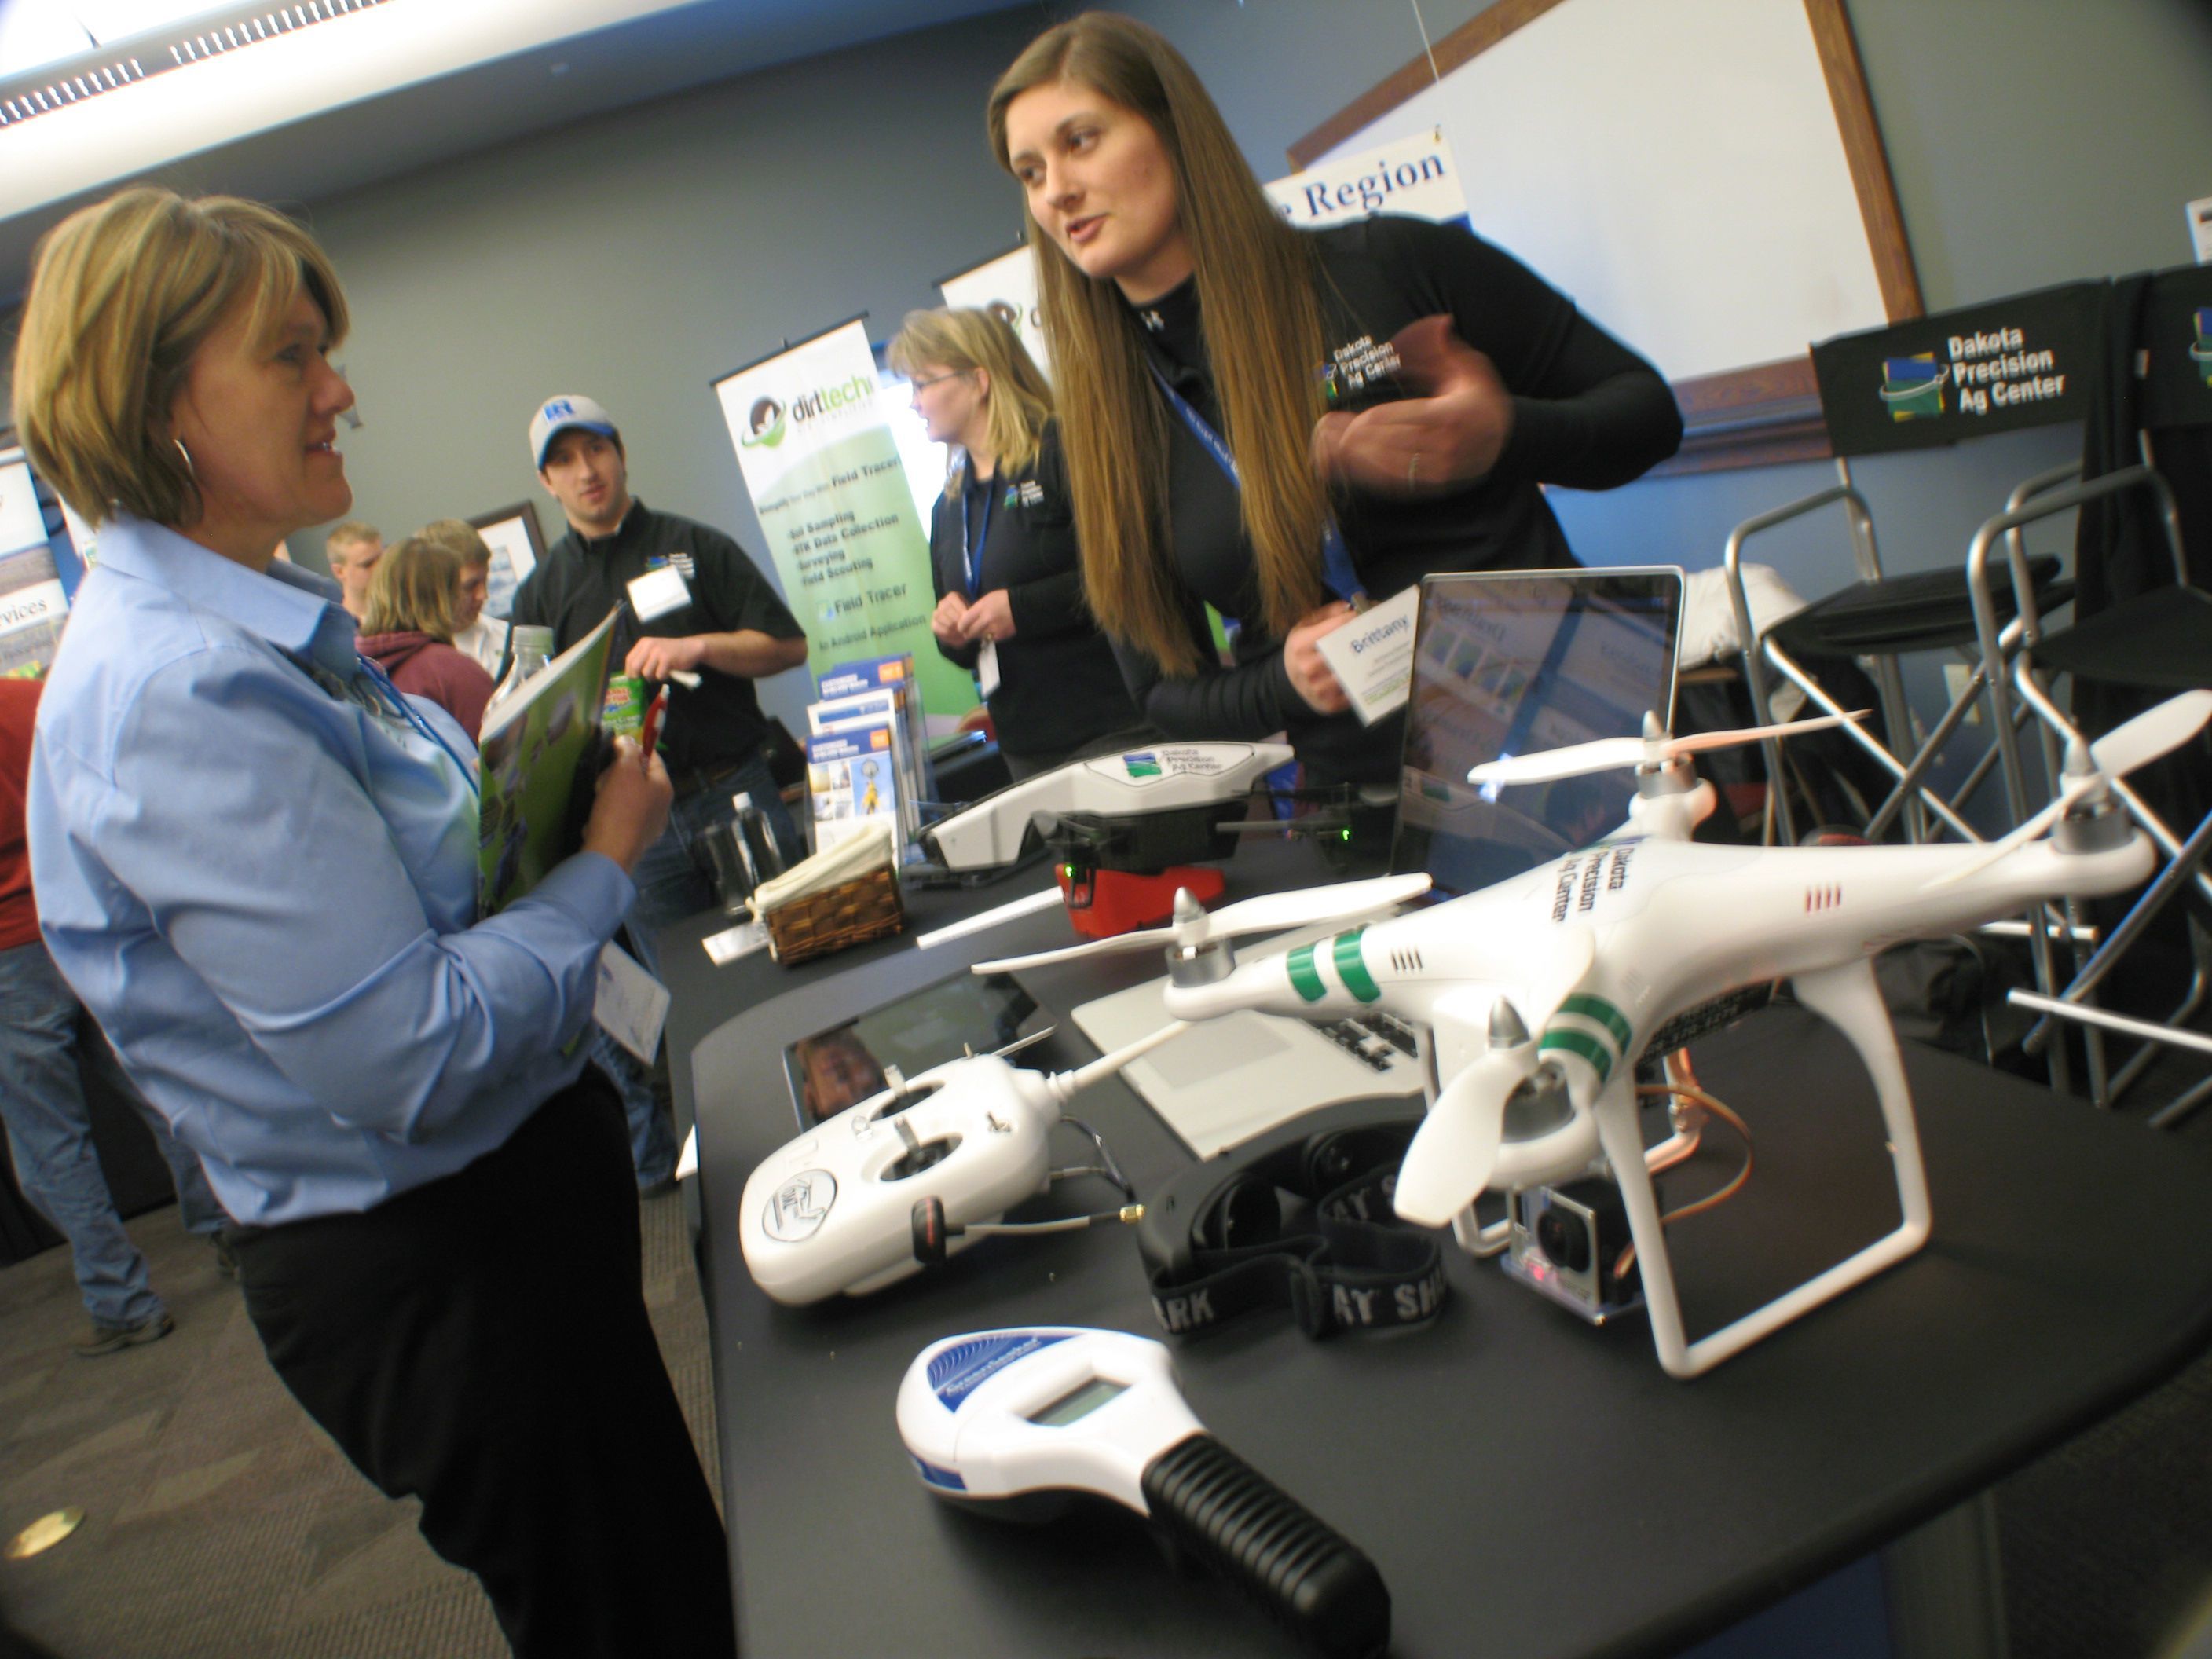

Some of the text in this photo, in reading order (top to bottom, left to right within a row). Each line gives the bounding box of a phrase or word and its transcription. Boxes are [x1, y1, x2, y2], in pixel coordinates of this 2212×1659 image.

[1302, 154, 1445, 216] Region
[1334, 335, 1372, 363] Dakota
[1340, 342, 1394, 378] Precision
[1947, 326, 2024, 361] Dakota
[1366, 354, 1401, 381] Center
[1952, 349, 2055, 387] Precision
[1959, 373, 2066, 416] Ag Center
[831, 471, 859, 488] Field
[861, 458, 899, 478] Tracer
[806, 511, 856, 533] Sampling
[814, 533, 838, 550] Data
[840, 513, 899, 539] Collection
[826, 558, 874, 579] Scouting
[0, 599, 48, 626] vices
[833, 584, 907, 614] Field Tracer
[870, 613, 928, 639] Application
[1350, 614, 1410, 654] Brittany
[1578, 851, 1609, 912] Precision
[1608, 848, 1635, 890] Dakota
[1552, 873, 1577, 922] Center
